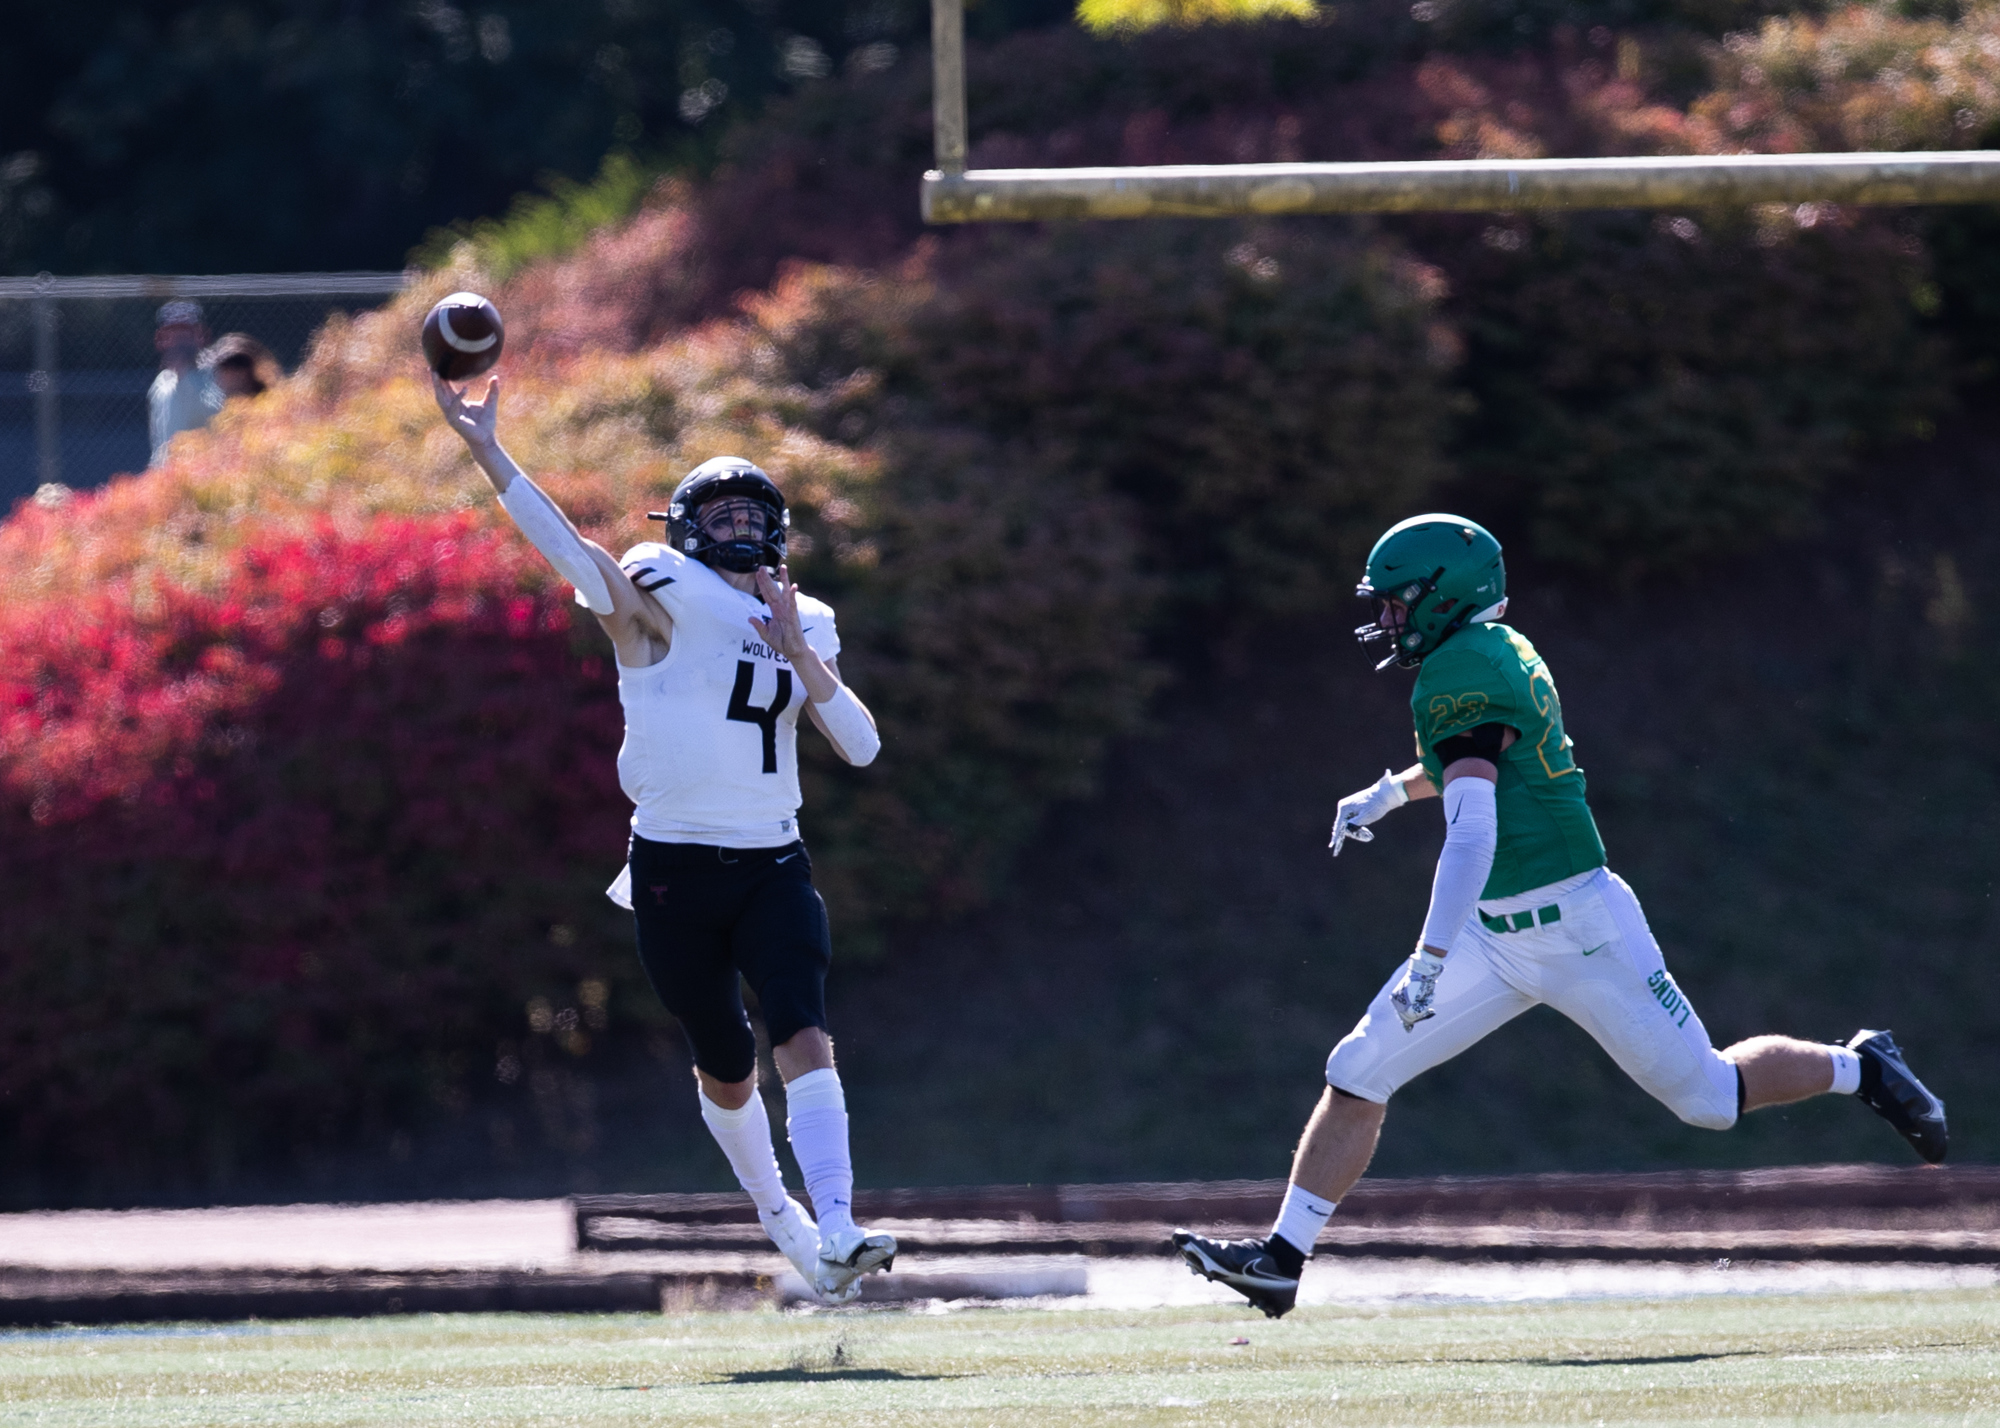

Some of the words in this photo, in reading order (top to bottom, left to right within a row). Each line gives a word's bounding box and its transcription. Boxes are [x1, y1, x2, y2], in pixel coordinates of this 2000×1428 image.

[726, 659, 792, 774] 4
[1429, 691, 1489, 734] 23
[1647, 969, 1690, 1029] LIONS
